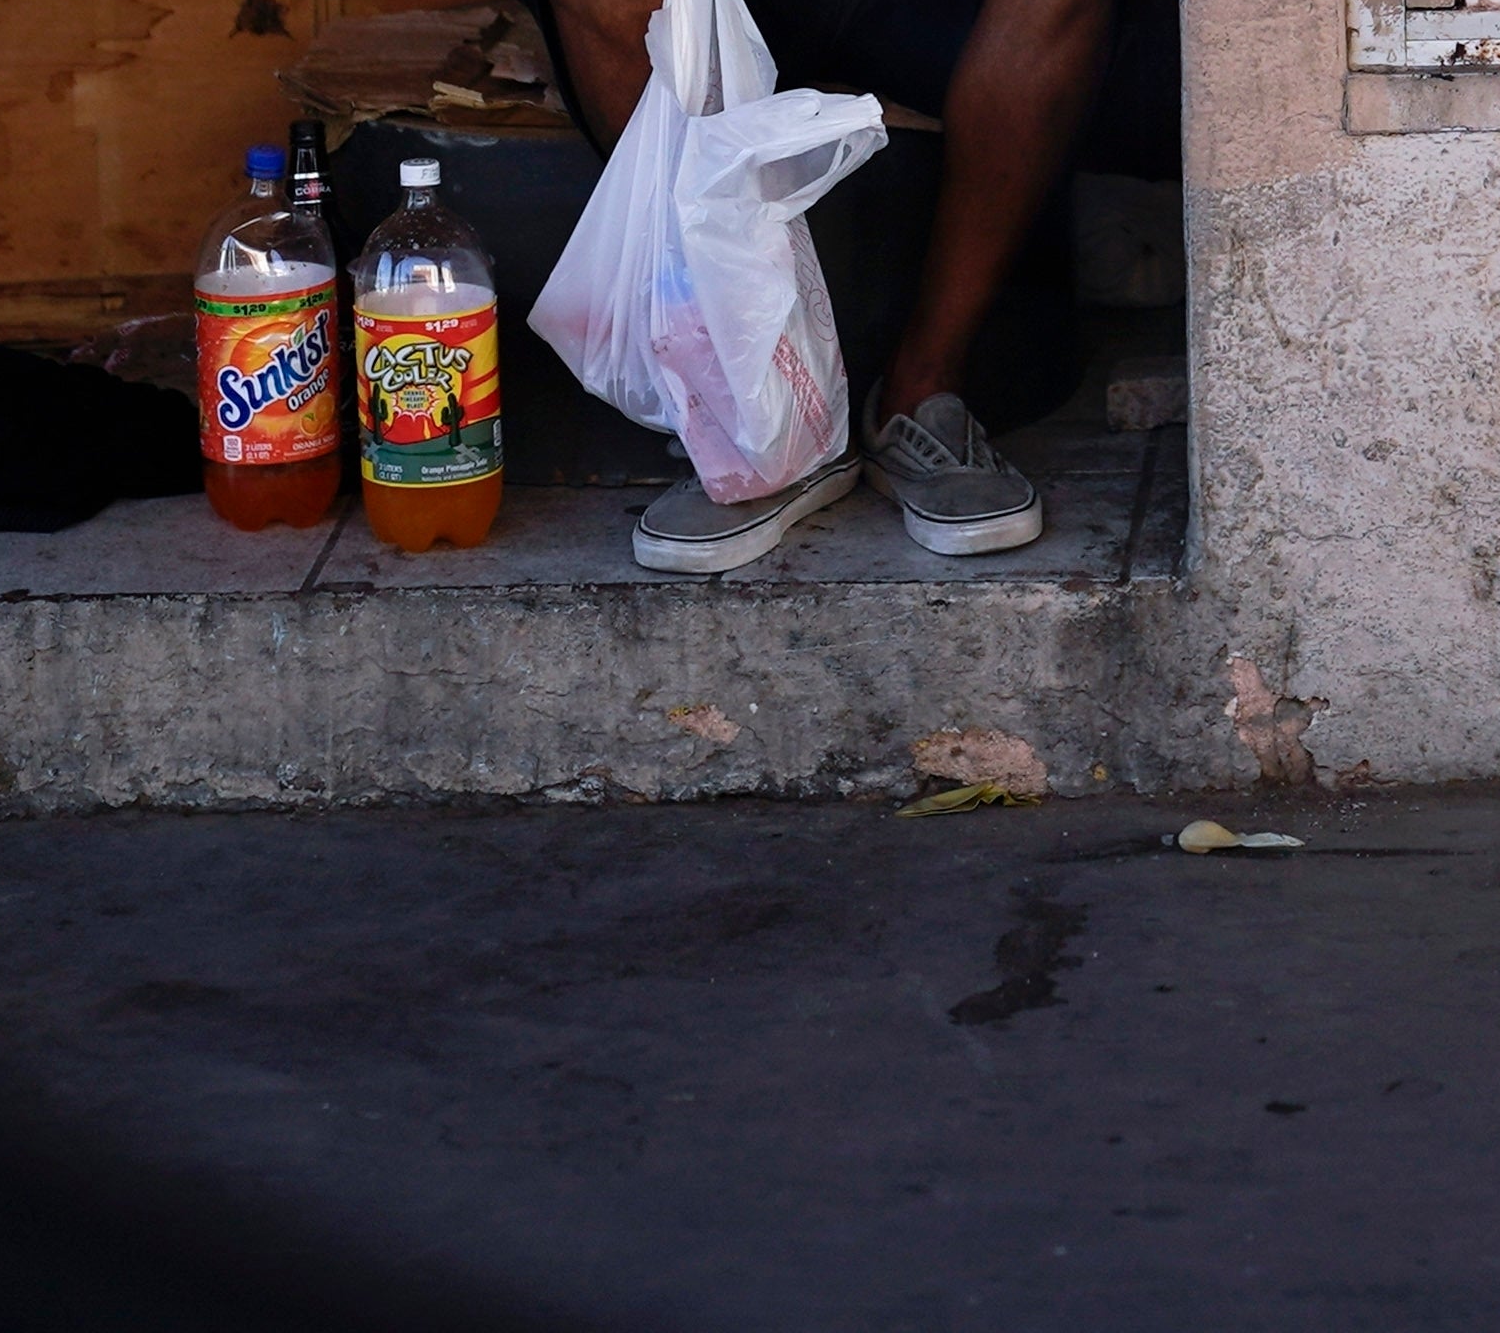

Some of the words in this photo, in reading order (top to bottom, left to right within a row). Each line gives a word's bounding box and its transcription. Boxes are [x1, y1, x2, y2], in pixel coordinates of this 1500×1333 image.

[425, 318, 460, 333] $1.29
[217, 308, 331, 432] Sunkist
[363, 341, 473, 381] CACTUS
[381, 364, 453, 393] COOLER
[287, 367, 330, 412] Orange
